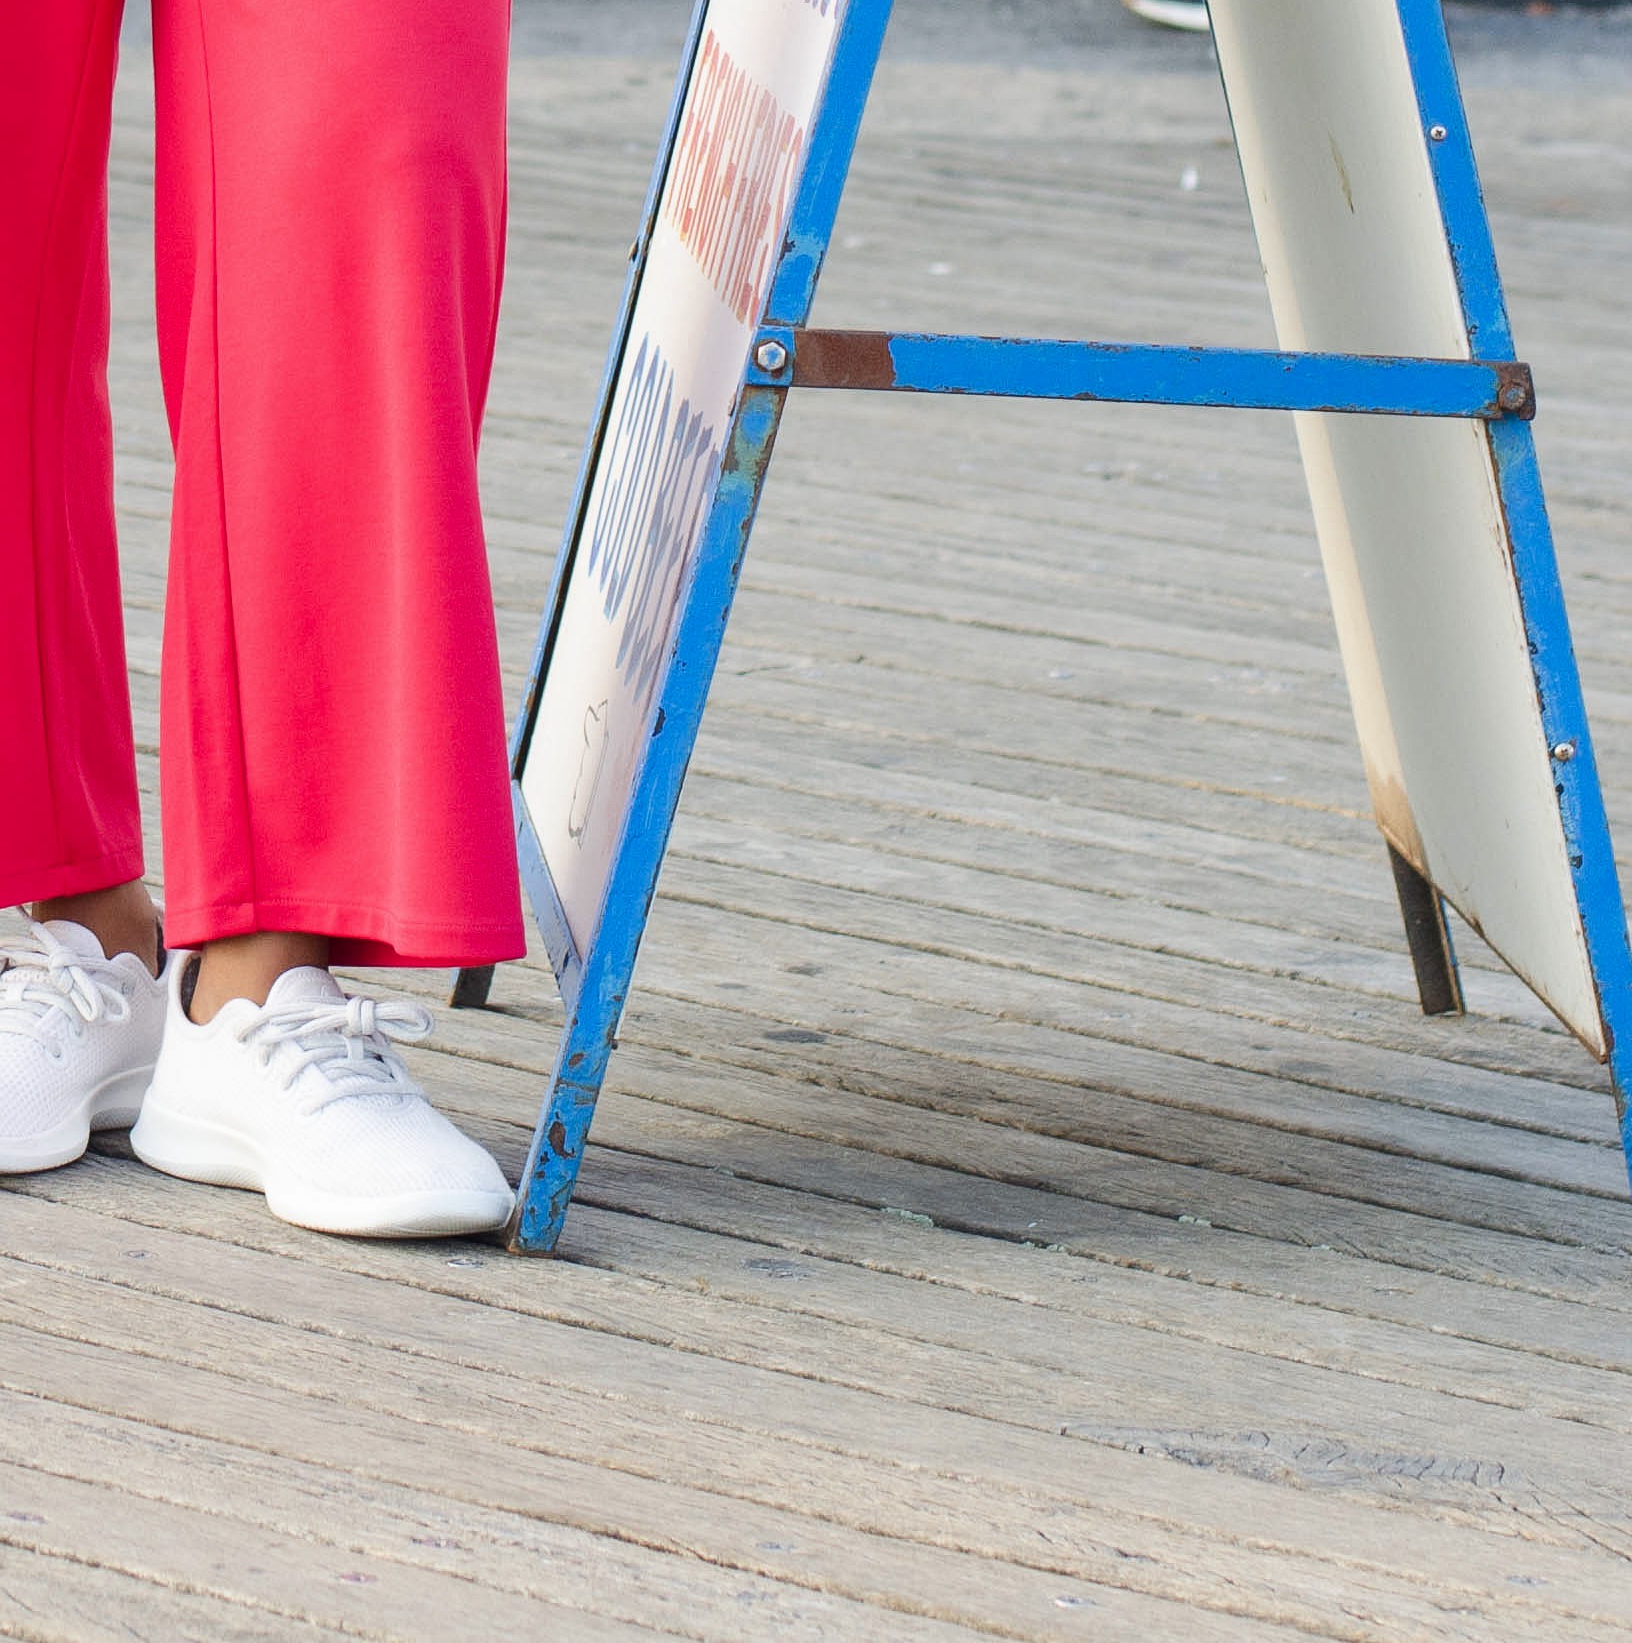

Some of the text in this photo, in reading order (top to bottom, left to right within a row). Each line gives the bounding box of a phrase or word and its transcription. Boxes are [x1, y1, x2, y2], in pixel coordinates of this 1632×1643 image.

[665, 28, 804, 332] FRENCH FRIES
[587, 330, 675, 622] COLD
